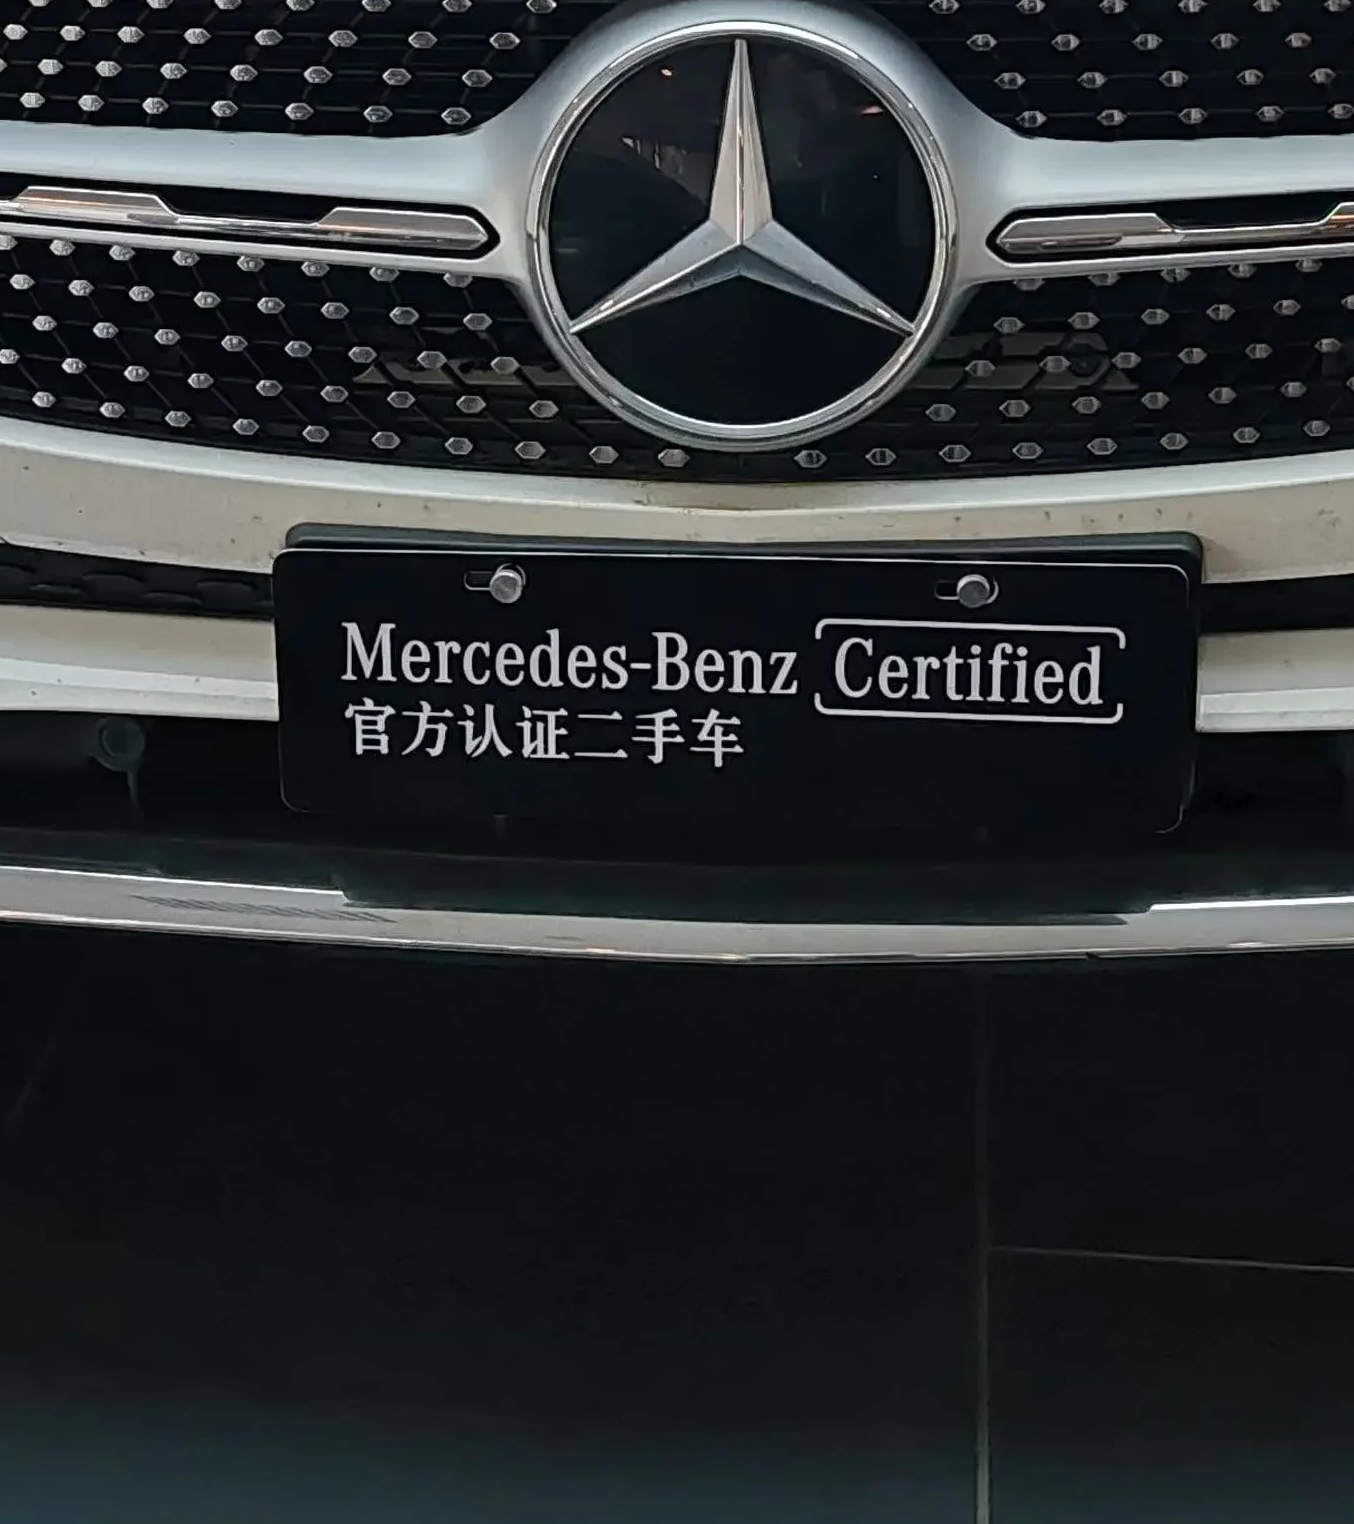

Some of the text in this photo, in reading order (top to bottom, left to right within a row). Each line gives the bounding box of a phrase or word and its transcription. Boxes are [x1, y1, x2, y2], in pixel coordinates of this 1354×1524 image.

[340, 622, 1104, 705] Mercedes-Benz Certified
[343, 697, 744, 768] 官方认证二手车
